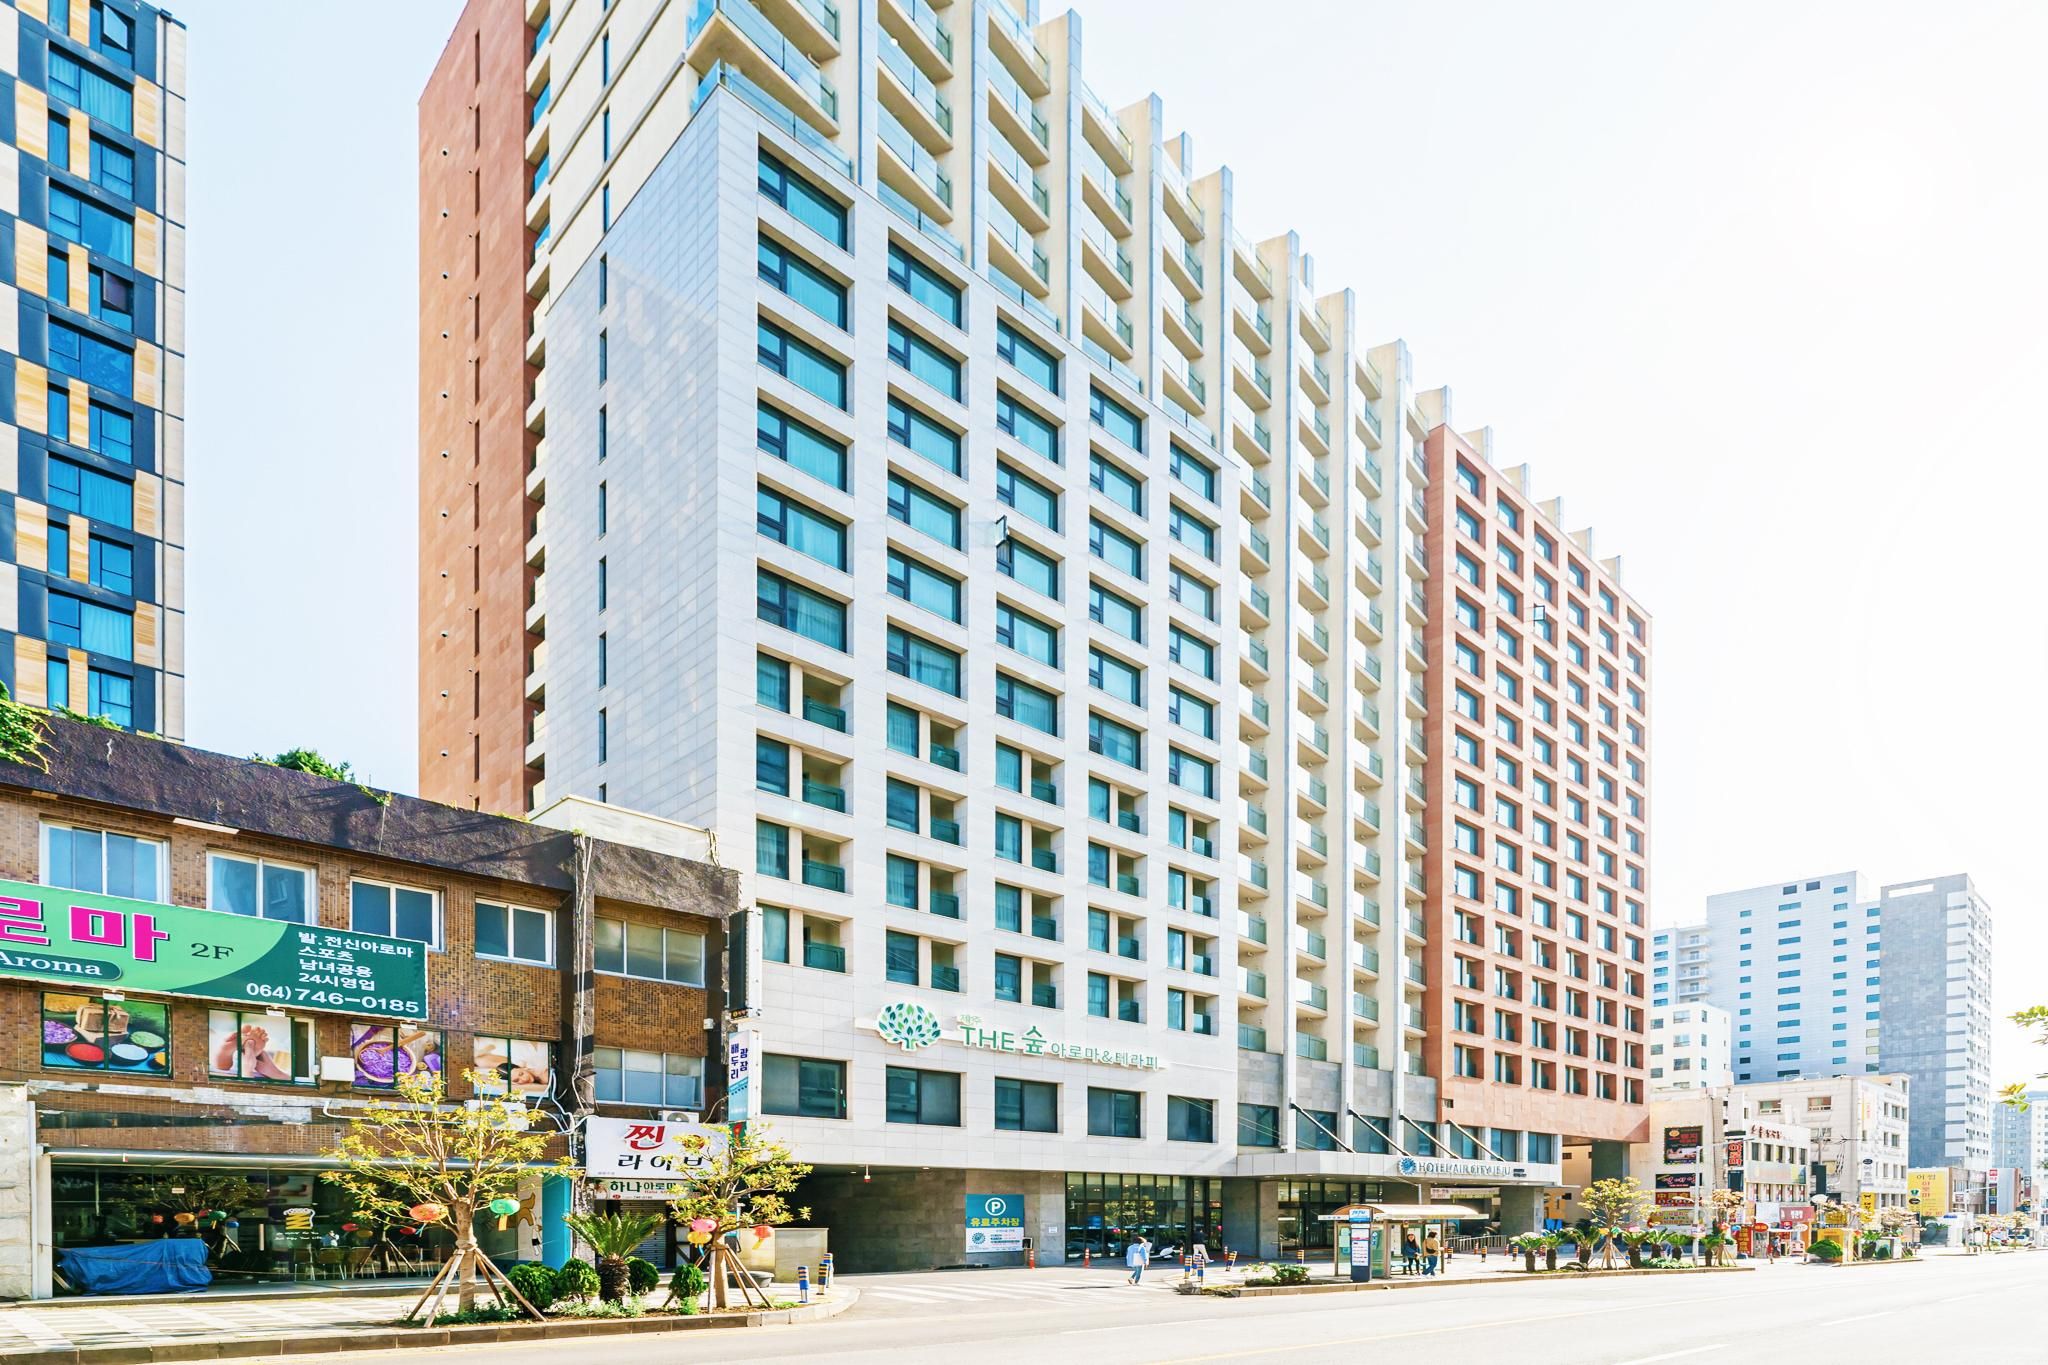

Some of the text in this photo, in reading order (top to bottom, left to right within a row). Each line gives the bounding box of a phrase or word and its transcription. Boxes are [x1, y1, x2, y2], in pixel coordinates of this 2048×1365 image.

[191, 943, 234, 960] 2F
[299, 946, 355, 962] 스포츠
[299, 959, 373, 978] 남녀공용
[299, 973, 375, 991] 24시영업
[294, 988, 419, 1013] 746-0185
[960, 1025, 1158, 1070] THE 숲 아로마&테라피
[624, 1124, 665, 1151] 찐
[1419, 1162, 1450, 1174] HOTEL
[970, 1217, 1020, 1227] 유료주차장
